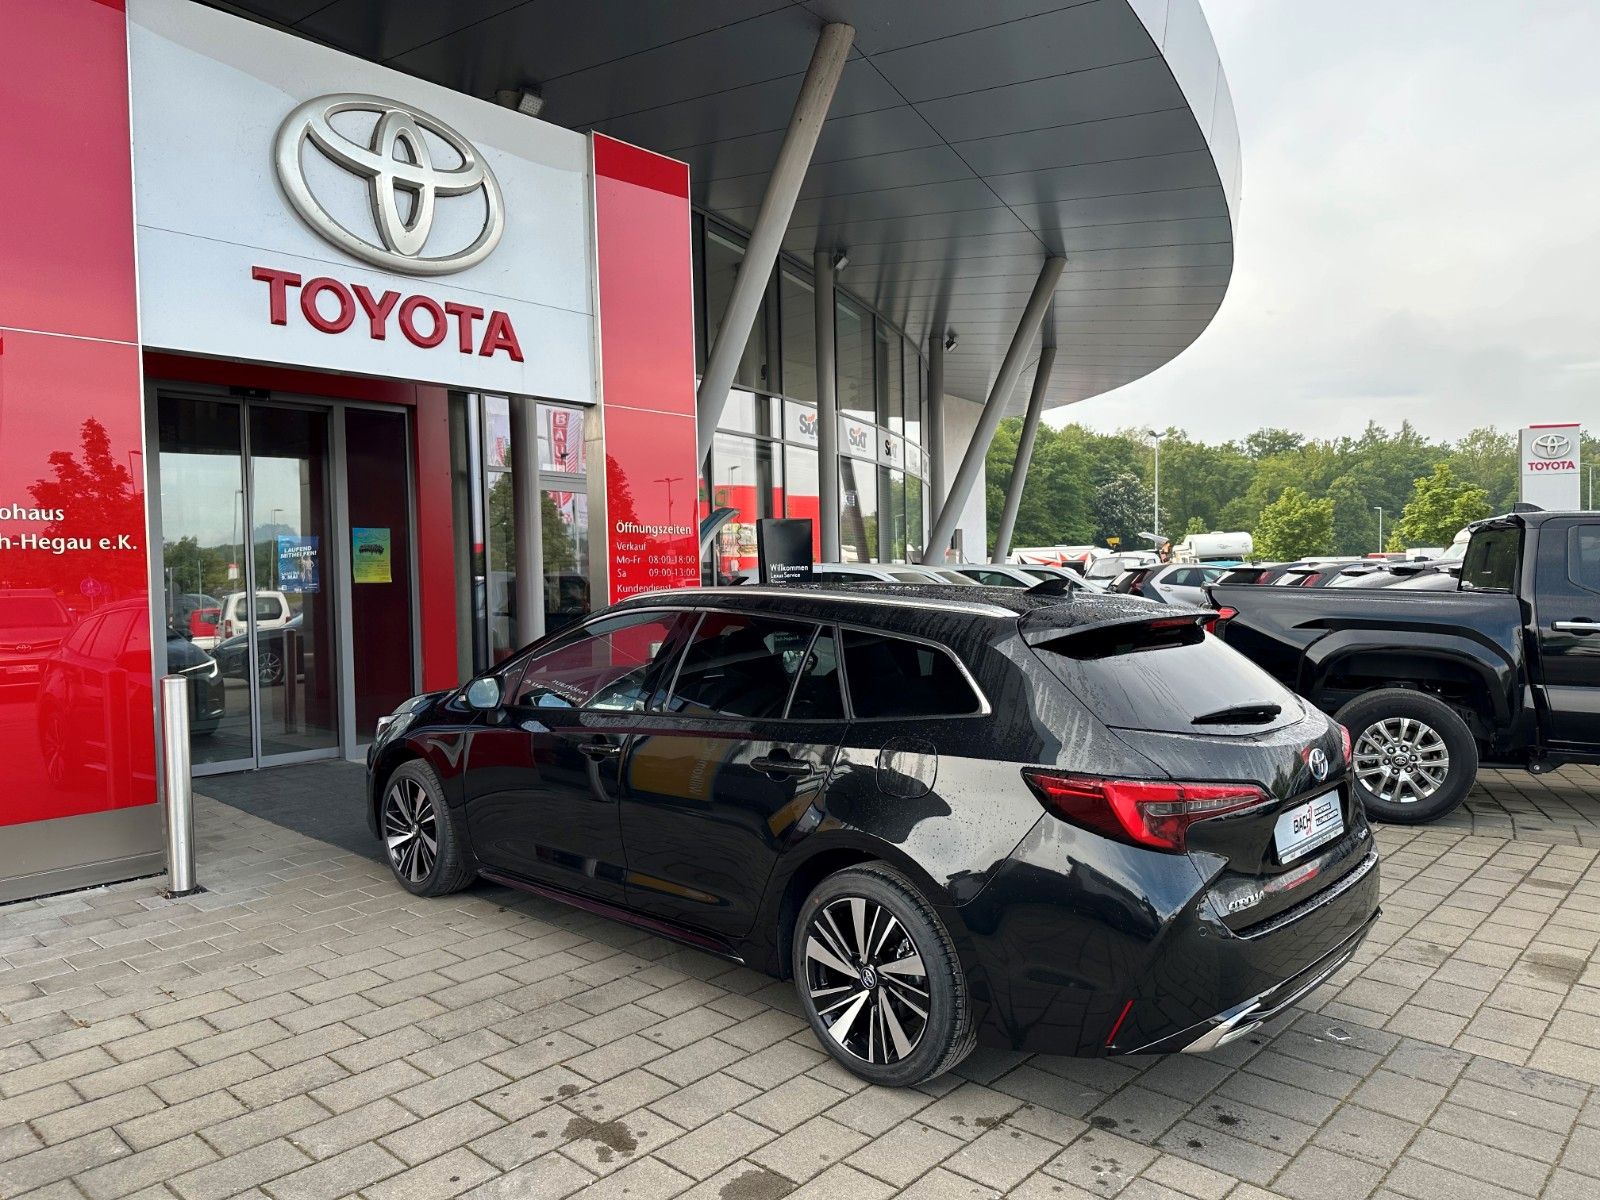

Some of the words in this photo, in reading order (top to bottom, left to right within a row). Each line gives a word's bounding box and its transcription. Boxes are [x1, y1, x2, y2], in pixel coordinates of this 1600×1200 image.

[252, 266, 524, 362] TOYOTA
[1528, 461, 1575, 471] TOYOTA
[0, 503, 65, 521] ohaus
[616, 520, 692, 537] Öffnungszeiten
[98, 534, 137, 550] e.K.
[616, 541, 647, 551] Verkauf
[616, 556, 641, 564] Mo-Fr
[617, 568, 627, 578] Sa
[1293, 808, 1311, 834] BACH
